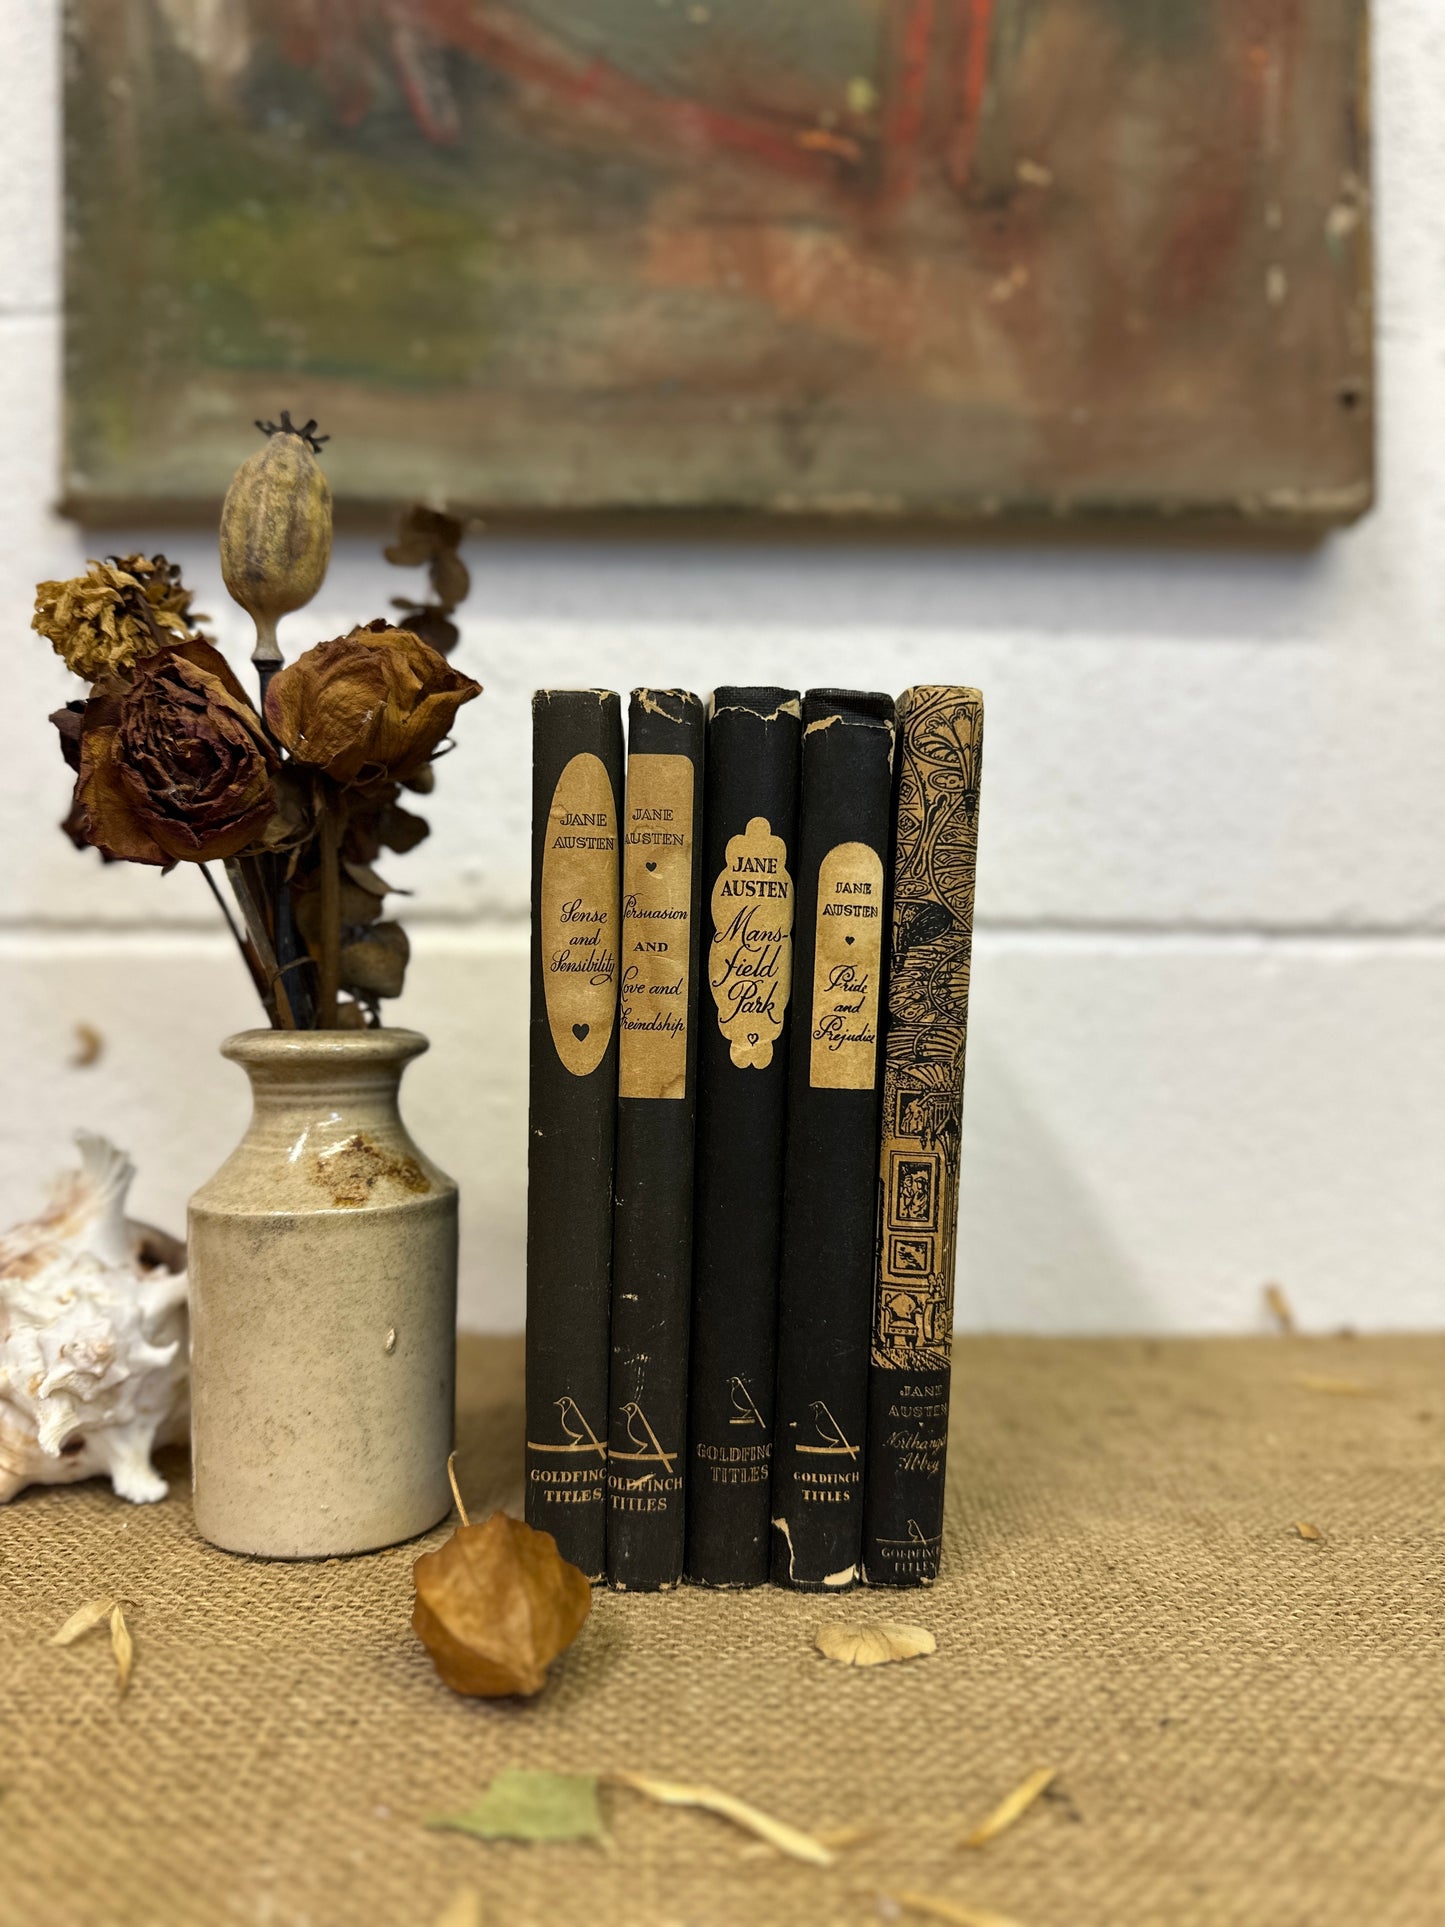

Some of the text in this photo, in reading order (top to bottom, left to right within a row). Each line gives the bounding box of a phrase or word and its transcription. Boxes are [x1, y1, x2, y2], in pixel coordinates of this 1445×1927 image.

[560, 812, 607, 827] JANE
[632, 808, 673, 821] JANE
[552, 836, 614, 850] AUSTEN
[624, 833, 684, 845] AUSTEN
[732, 857, 777, 874] JANE
[721, 881, 788, 899] AUSTEN
[835, 882, 872, 895] JANE
[560, 898, 607, 924] Sense
[623, 892, 688, 920] Persuasion
[823, 904, 878, 917] AUSTEN
[714, 905, 788, 943] Mans-
[569, 929, 601, 946] and
[633, 941, 668, 952] AND
[550, 949, 615, 985] Sensibility
[712, 943, 782, 987] field
[649, 978, 682, 995] and
[823, 965, 868, 994] Pride
[720, 980, 782, 1024] Park
[834, 996, 862, 1014] and
[812, 1015, 875, 1051] Prejudice
[888, 1403, 947, 1417] AUSTEN
[697, 1442, 772, 1462] GOLDFINC
[531, 1467, 606, 1482] GOLDFINC
[710, 1465, 768, 1483] TITLES
[793, 1471, 860, 1483] GOLDFINCH
[608, 1475, 683, 1492] OLDFINCH
[544, 1488, 602, 1502] TITLES
[611, 1494, 667, 1511] TITLES
[802, 1489, 850, 1502] TITLES
